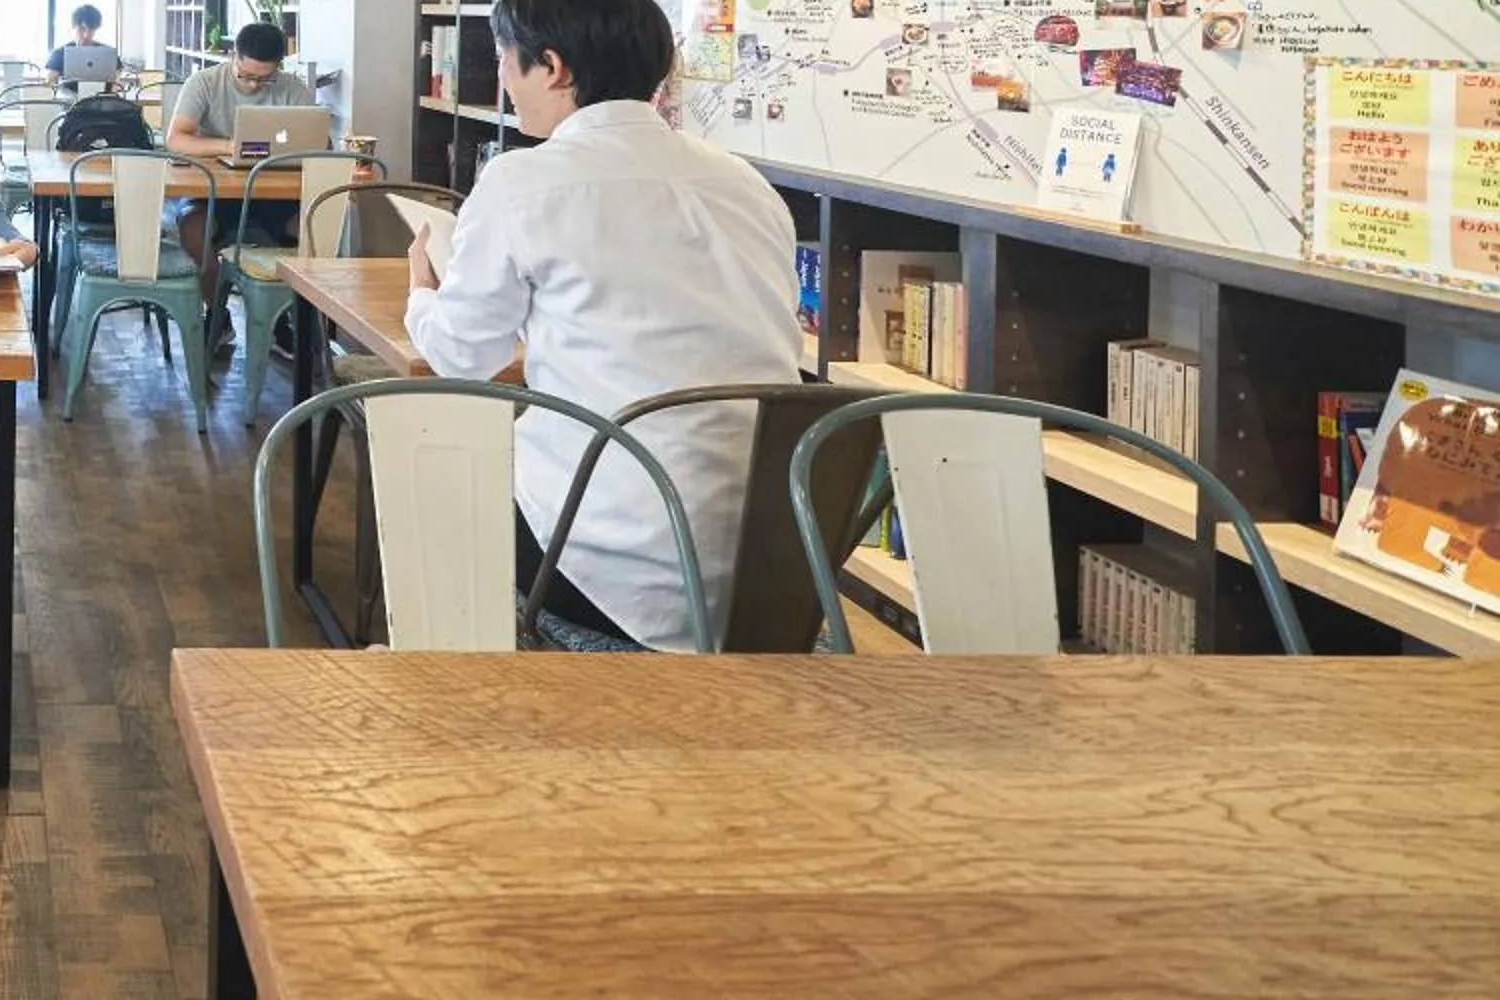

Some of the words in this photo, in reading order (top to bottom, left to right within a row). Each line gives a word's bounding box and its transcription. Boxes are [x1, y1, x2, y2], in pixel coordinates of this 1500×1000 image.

[1341, 71, 1412, 85] こんにちは
[1463, 73, 1500, 89] ごめ
[1071, 114, 1116, 131] SOCIAL
[1357, 109, 1386, 120] Hello
[1060, 127, 1123, 145] DISTANCE
[1205, 94, 1270, 170] Shinkansen
[1348, 129, 1404, 145] おはよう
[1339, 143, 1411, 159] ございます
[1368, 184, 1409, 197] morning
[1339, 202, 1411, 222] こんばんは
